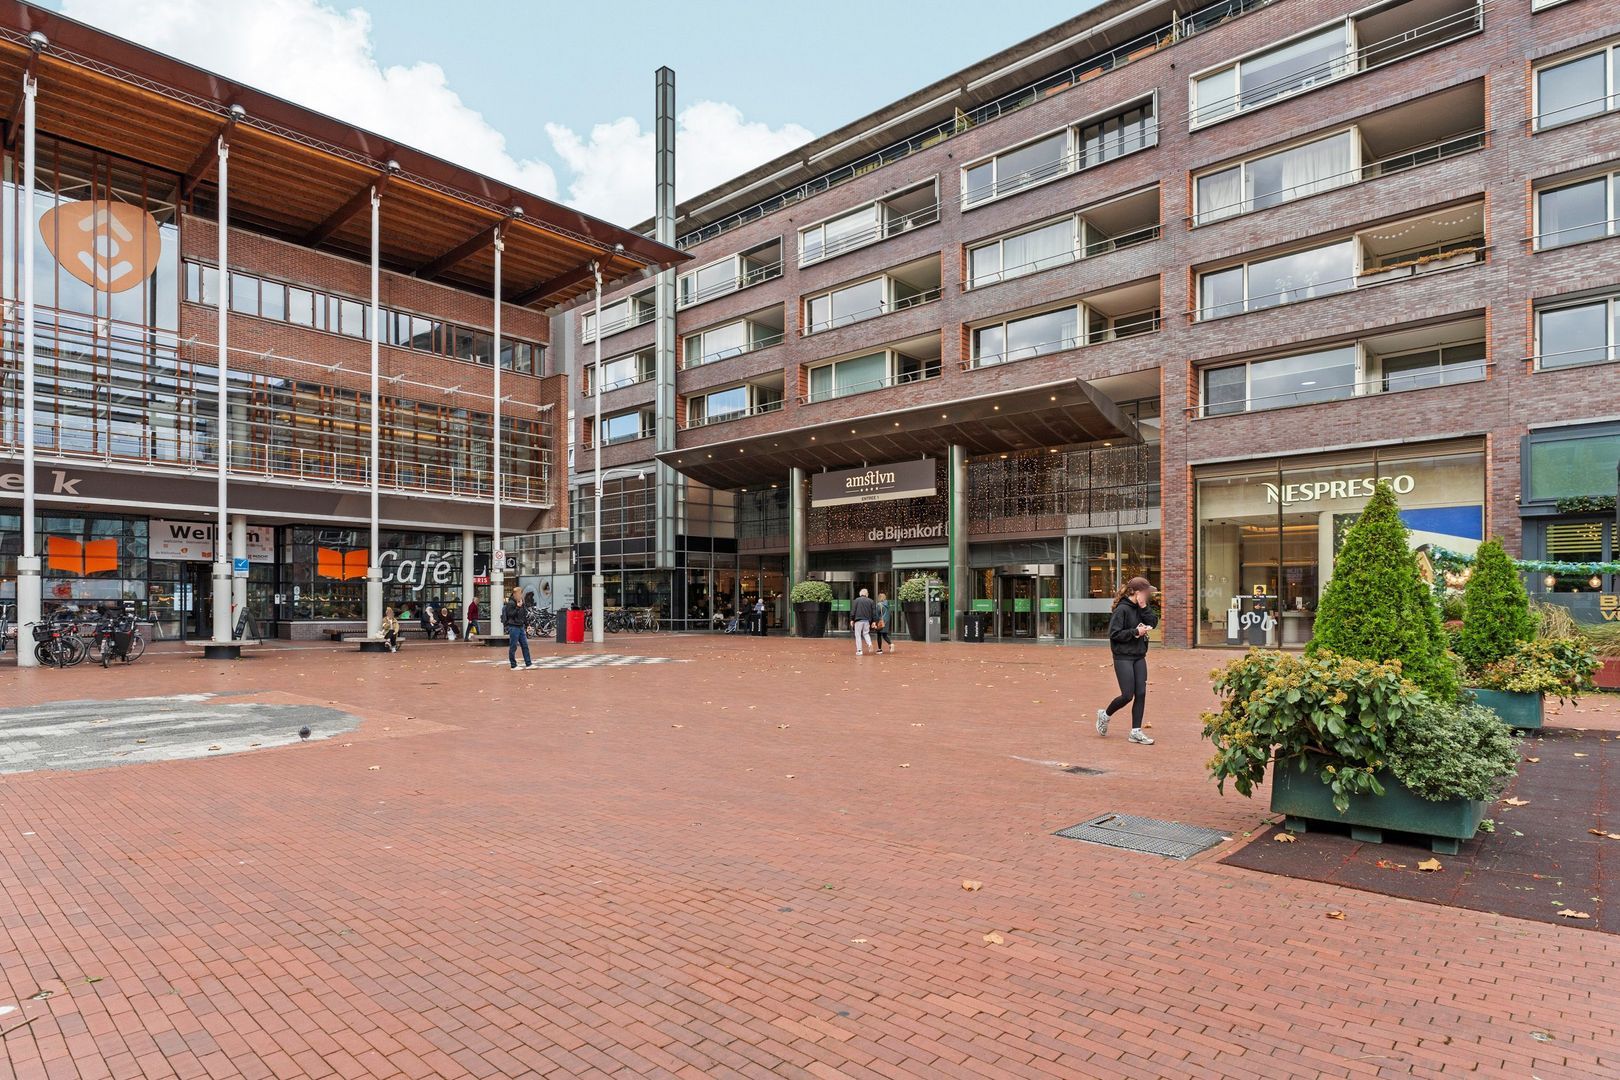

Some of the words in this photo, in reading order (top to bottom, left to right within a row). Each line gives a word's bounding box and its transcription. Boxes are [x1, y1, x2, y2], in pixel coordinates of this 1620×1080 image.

[169, 524, 260, 543] Welm
[868, 527, 884, 541] de
[885, 522, 943, 542] Bijenkorf
[378, 550, 453, 591] Café
